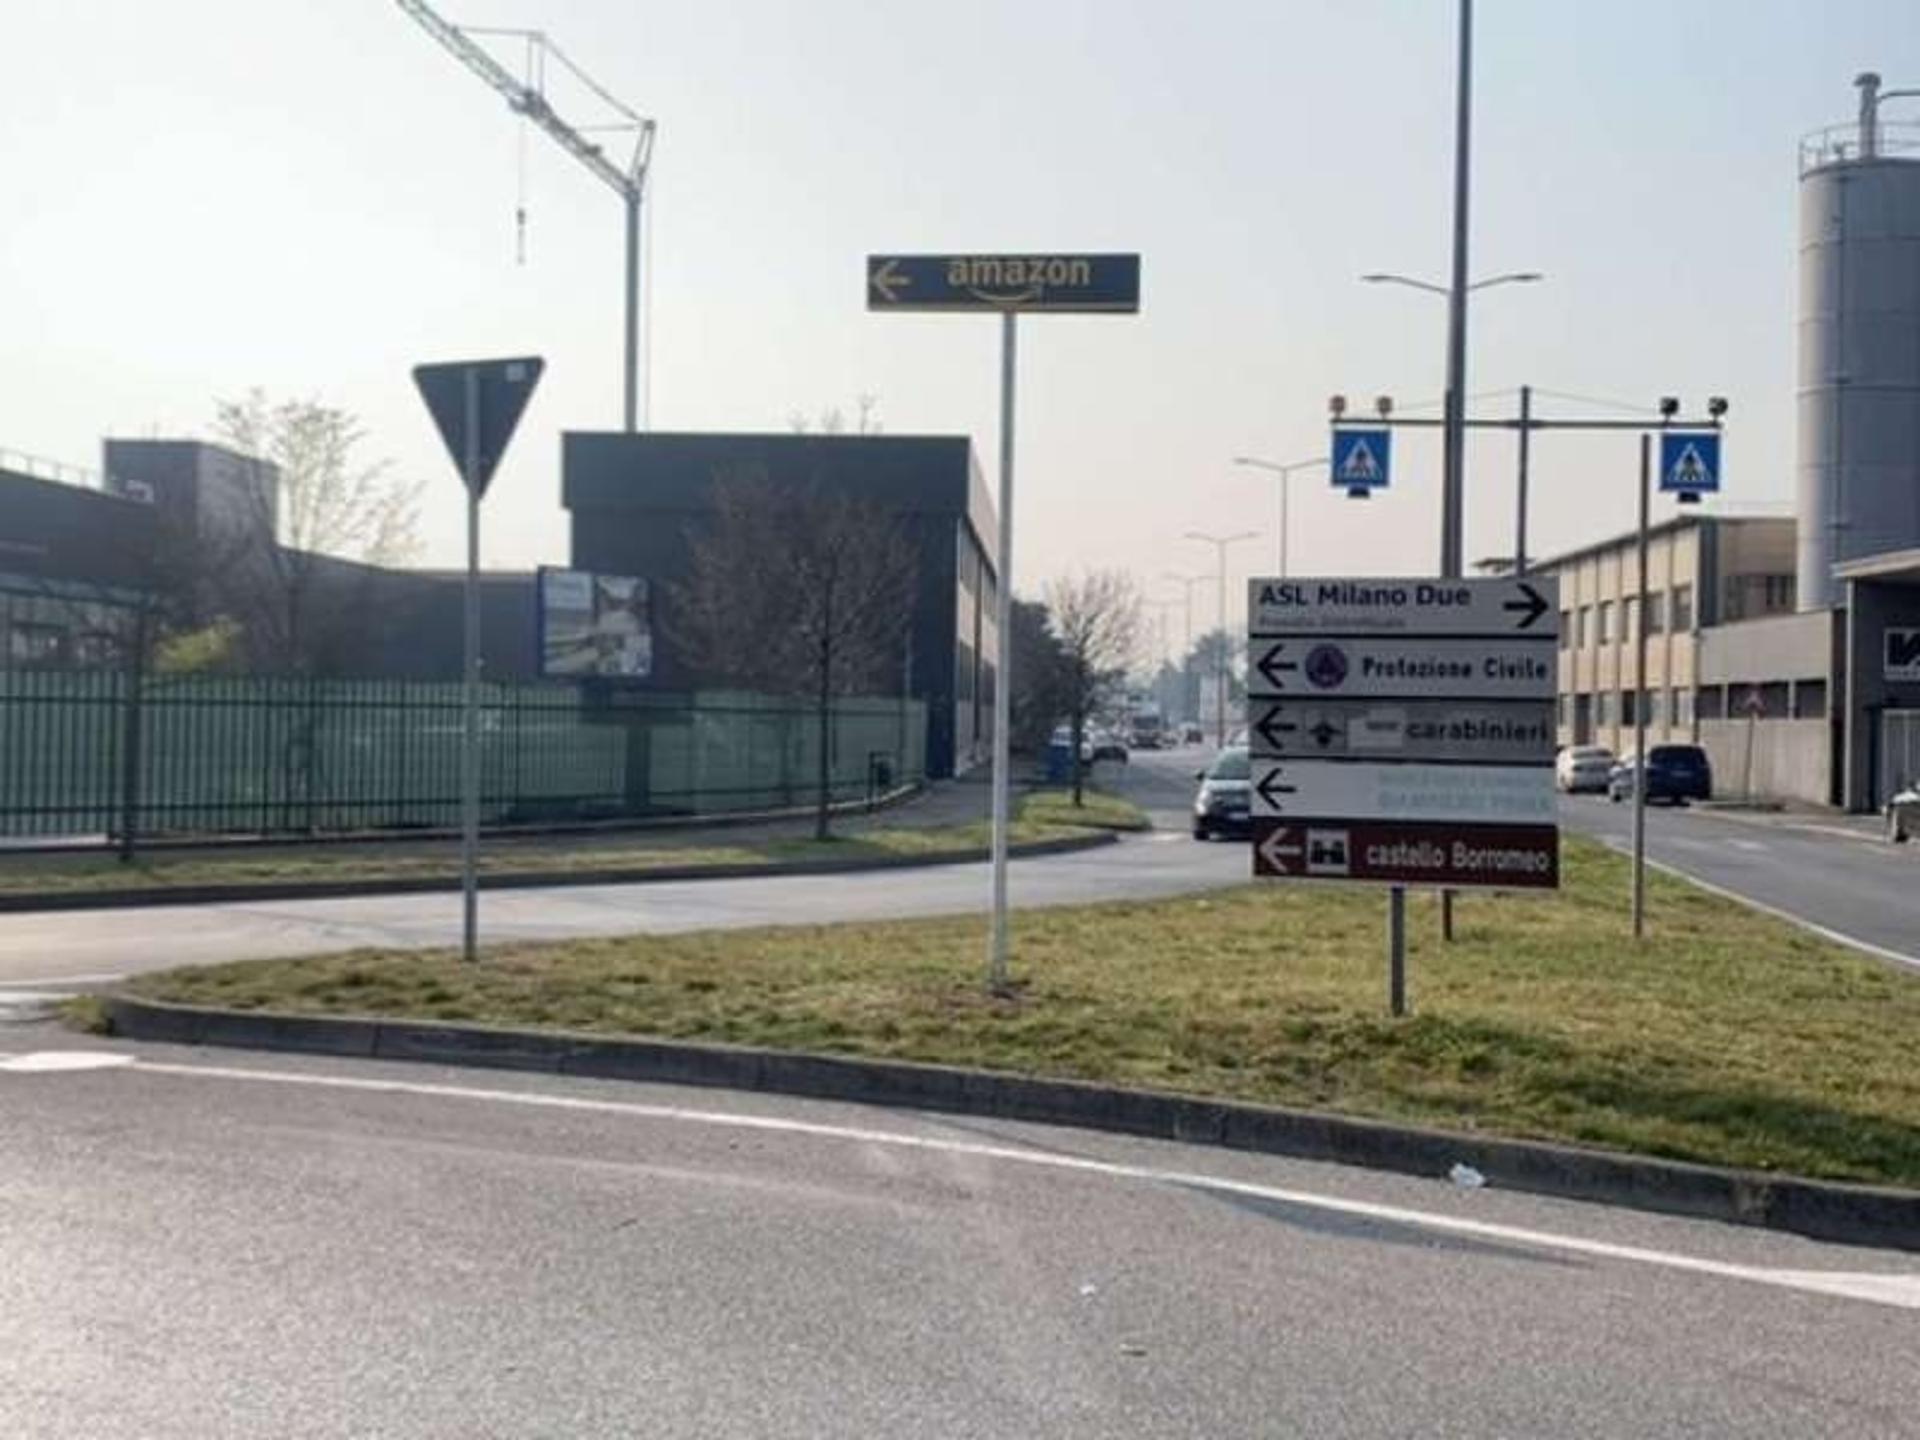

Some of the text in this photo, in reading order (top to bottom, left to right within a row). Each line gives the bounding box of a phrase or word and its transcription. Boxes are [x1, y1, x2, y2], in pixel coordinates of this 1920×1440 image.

[947, 259, 1091, 286] amazon
[1259, 583, 1471, 606] ASL Milano Due
[1362, 657, 1548, 680] Protezione Civile
[1405, 718, 1548, 743] carabinieri
[1366, 843, 1550, 872] castello Borromeo
